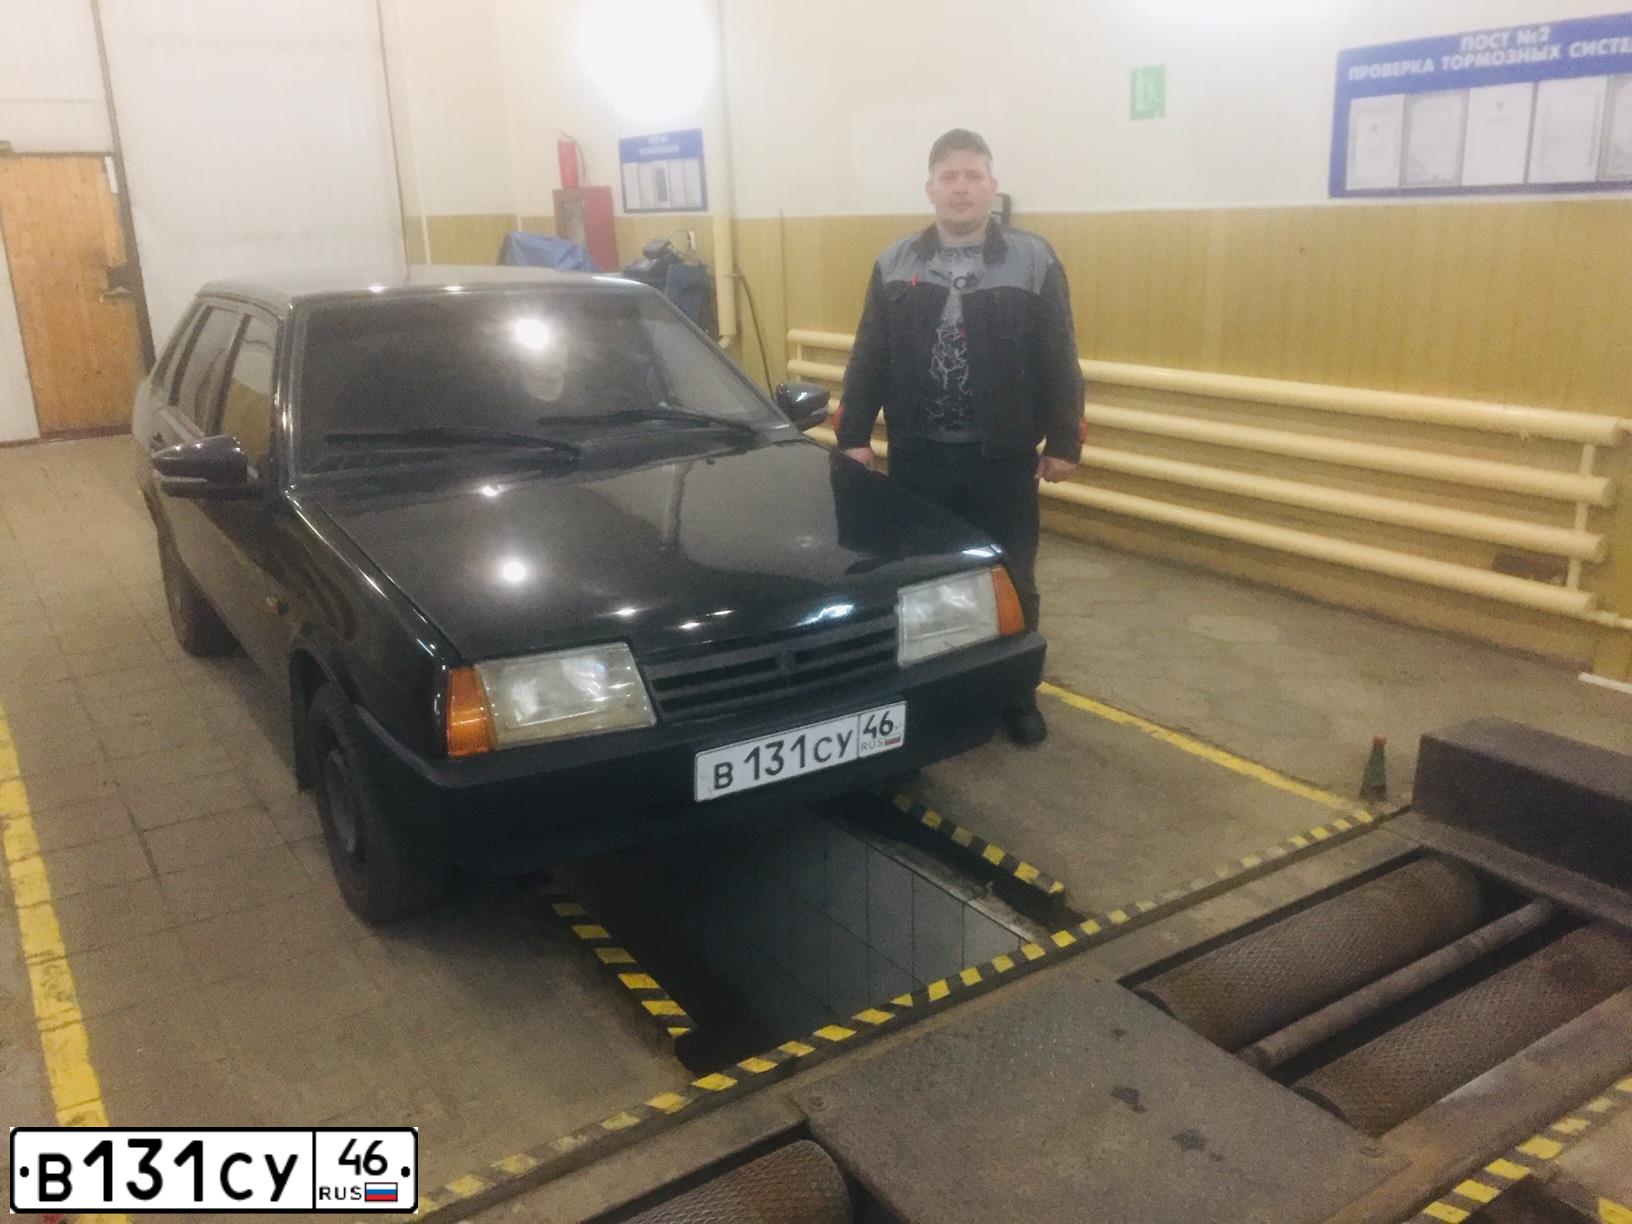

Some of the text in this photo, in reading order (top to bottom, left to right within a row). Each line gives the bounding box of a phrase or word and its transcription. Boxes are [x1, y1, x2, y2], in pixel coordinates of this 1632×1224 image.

[1461, 32, 1510, 51] ПОСТ
[1348, 58, 1435, 80] ПРОВЕРКА
[1442, 44, 1561, 71] ТОРМОЗНЫХ
[863, 711, 894, 739] 46
[860, 740, 884, 752] RUS
